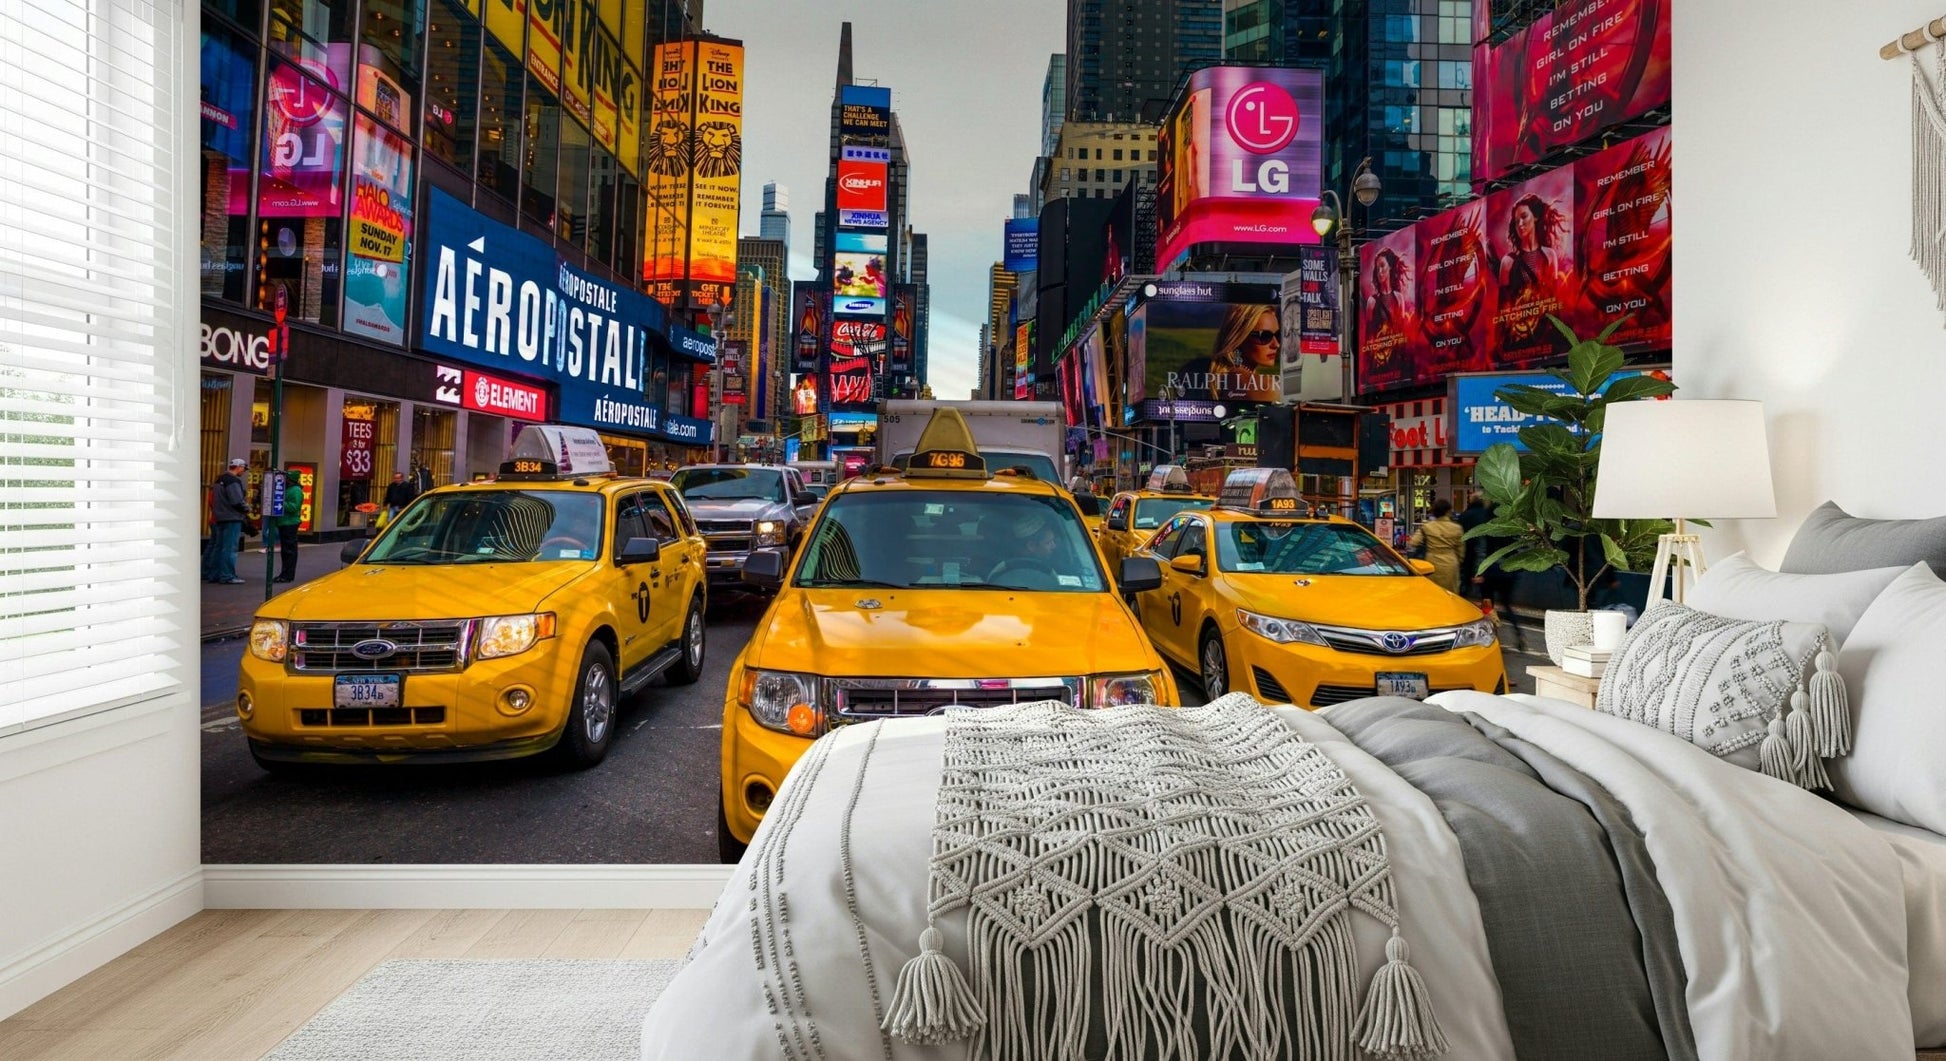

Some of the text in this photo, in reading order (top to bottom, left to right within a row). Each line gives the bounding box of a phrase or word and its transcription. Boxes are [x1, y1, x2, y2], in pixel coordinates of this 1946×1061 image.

[1543, 0, 1610, 42] REMEMBE
[1537, 11, 1623, 69] GIRL ON FIRE
[530, 53, 559, 89] ENTRANCE
[578, 4, 634, 123] KING
[707, 60, 733, 73] THE
[1549, 48, 1608, 86] I'M STILL
[702, 73, 737, 91] LION
[1550, 72, 1607, 110] BETTING
[699, 93, 740, 113] KING
[844, 105, 865, 113] THAT'S
[843, 112, 880, 121] CHALLENGE
[855, 119, 869, 127] CAN
[870, 120, 888, 128] MEET
[1554, 99, 1603, 132] ON YOU
[1232, 159, 1290, 193] LG
[1597, 160, 1655, 187] REMEMBER
[697, 194, 734, 203] REMEMBER
[1592, 192, 1660, 221] GIRL ON FIRE
[851, 212, 881, 220] XINHUA
[361, 223, 398, 245] SUNDAY
[1233, 224, 1287, 233] www.LG.com
[1430, 228, 1468, 246] REMEMBER
[360, 237, 392, 257] NOV. 17
[1603, 230, 1648, 250] I'M STILL
[1303, 259, 1325, 270] SOME
[1428, 253, 1471, 273] GIRL ON FIRE
[1303, 271, 1328, 281] WALLS
[1603, 263, 1648, 282] BETTING
[558, 262, 617, 313] AÉROPOSTALE
[701, 284, 719, 292] GET
[1158, 286, 1212, 297] sunglass hut
[1446, 283, 1464, 294] STILL
[1303, 292, 1321, 303] TALK
[1606, 298, 1646, 313] ON YOU
[1434, 309, 1464, 322] BETTING
[1493, 302, 1564, 324] CATCHING FIRE
[1446, 336, 1462, 346] YOU
[1168, 371, 1281, 391] RALPH LAUR
[490, 384, 538, 413] ELEMENT
[594, 394, 657, 429] AÉROPOSTALE
[883, 415, 900, 424] 505
[348, 422, 373, 438] TEES
[1435, 417, 1448, 446] L
[1482, 425, 1491, 434] to
[353, 440, 358, 448] 3
[346, 450, 372, 473] $33
[514, 462, 541, 473] 3B34
[929, 453, 965, 467] 7G95
[300, 474, 313, 486] ES
[1271, 499, 1295, 509] 1A93
